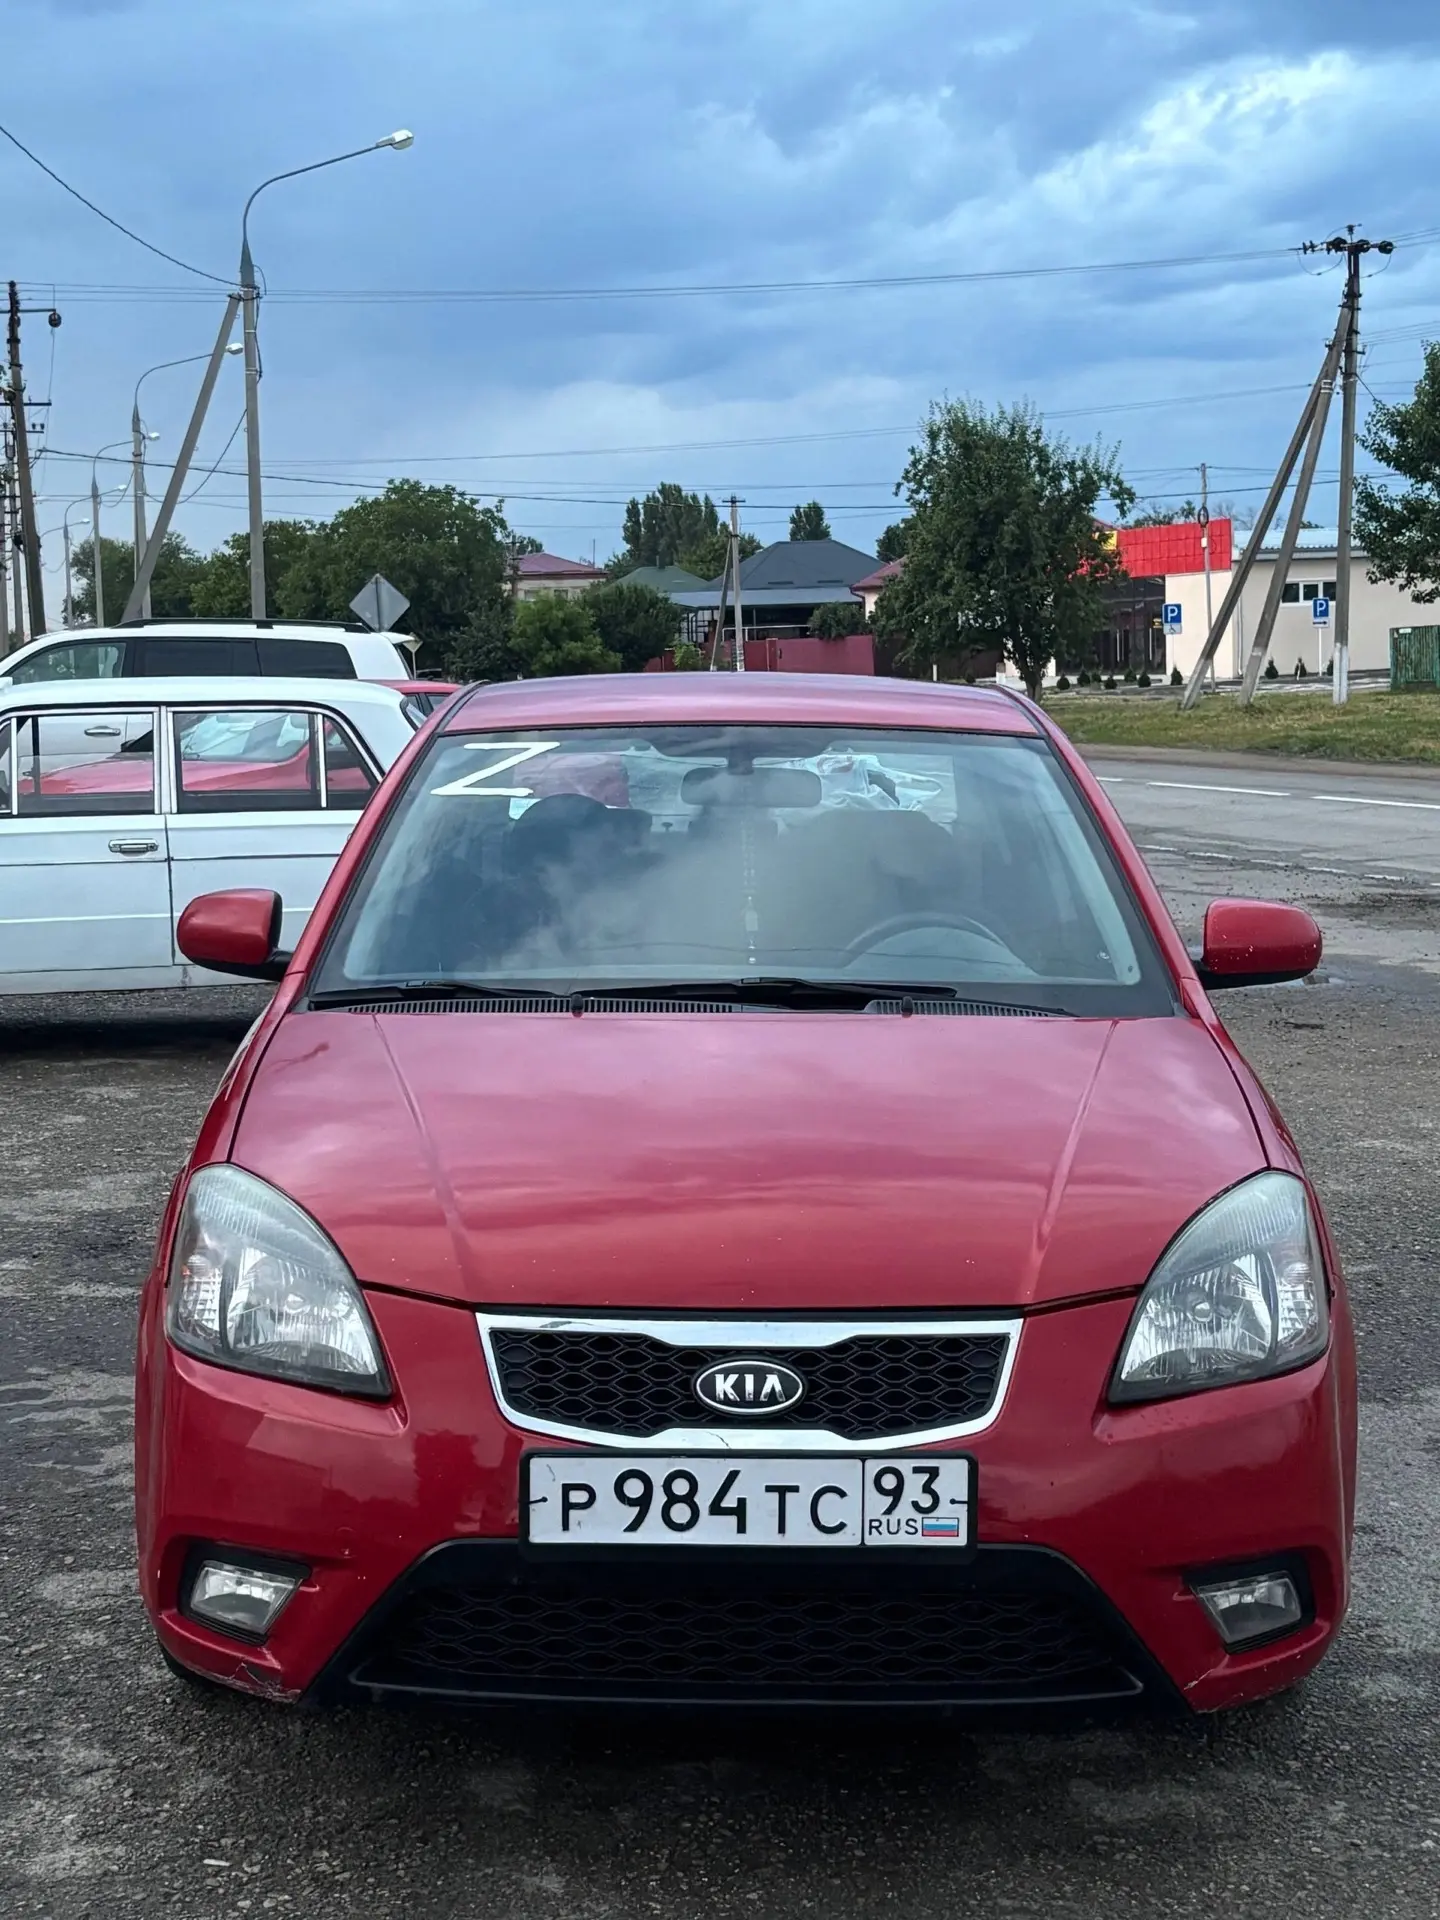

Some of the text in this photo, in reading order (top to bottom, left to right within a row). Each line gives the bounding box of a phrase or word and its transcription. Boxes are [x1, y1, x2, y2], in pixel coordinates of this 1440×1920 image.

[1167, 605, 1178, 622] P
[1316, 600, 1327, 616] P
[430, 741, 560, 797] Z
[714, 1373, 786, 1402] KIA
[873, 1465, 940, 1516] 93
[868, 1518, 919, 1536] RUS
